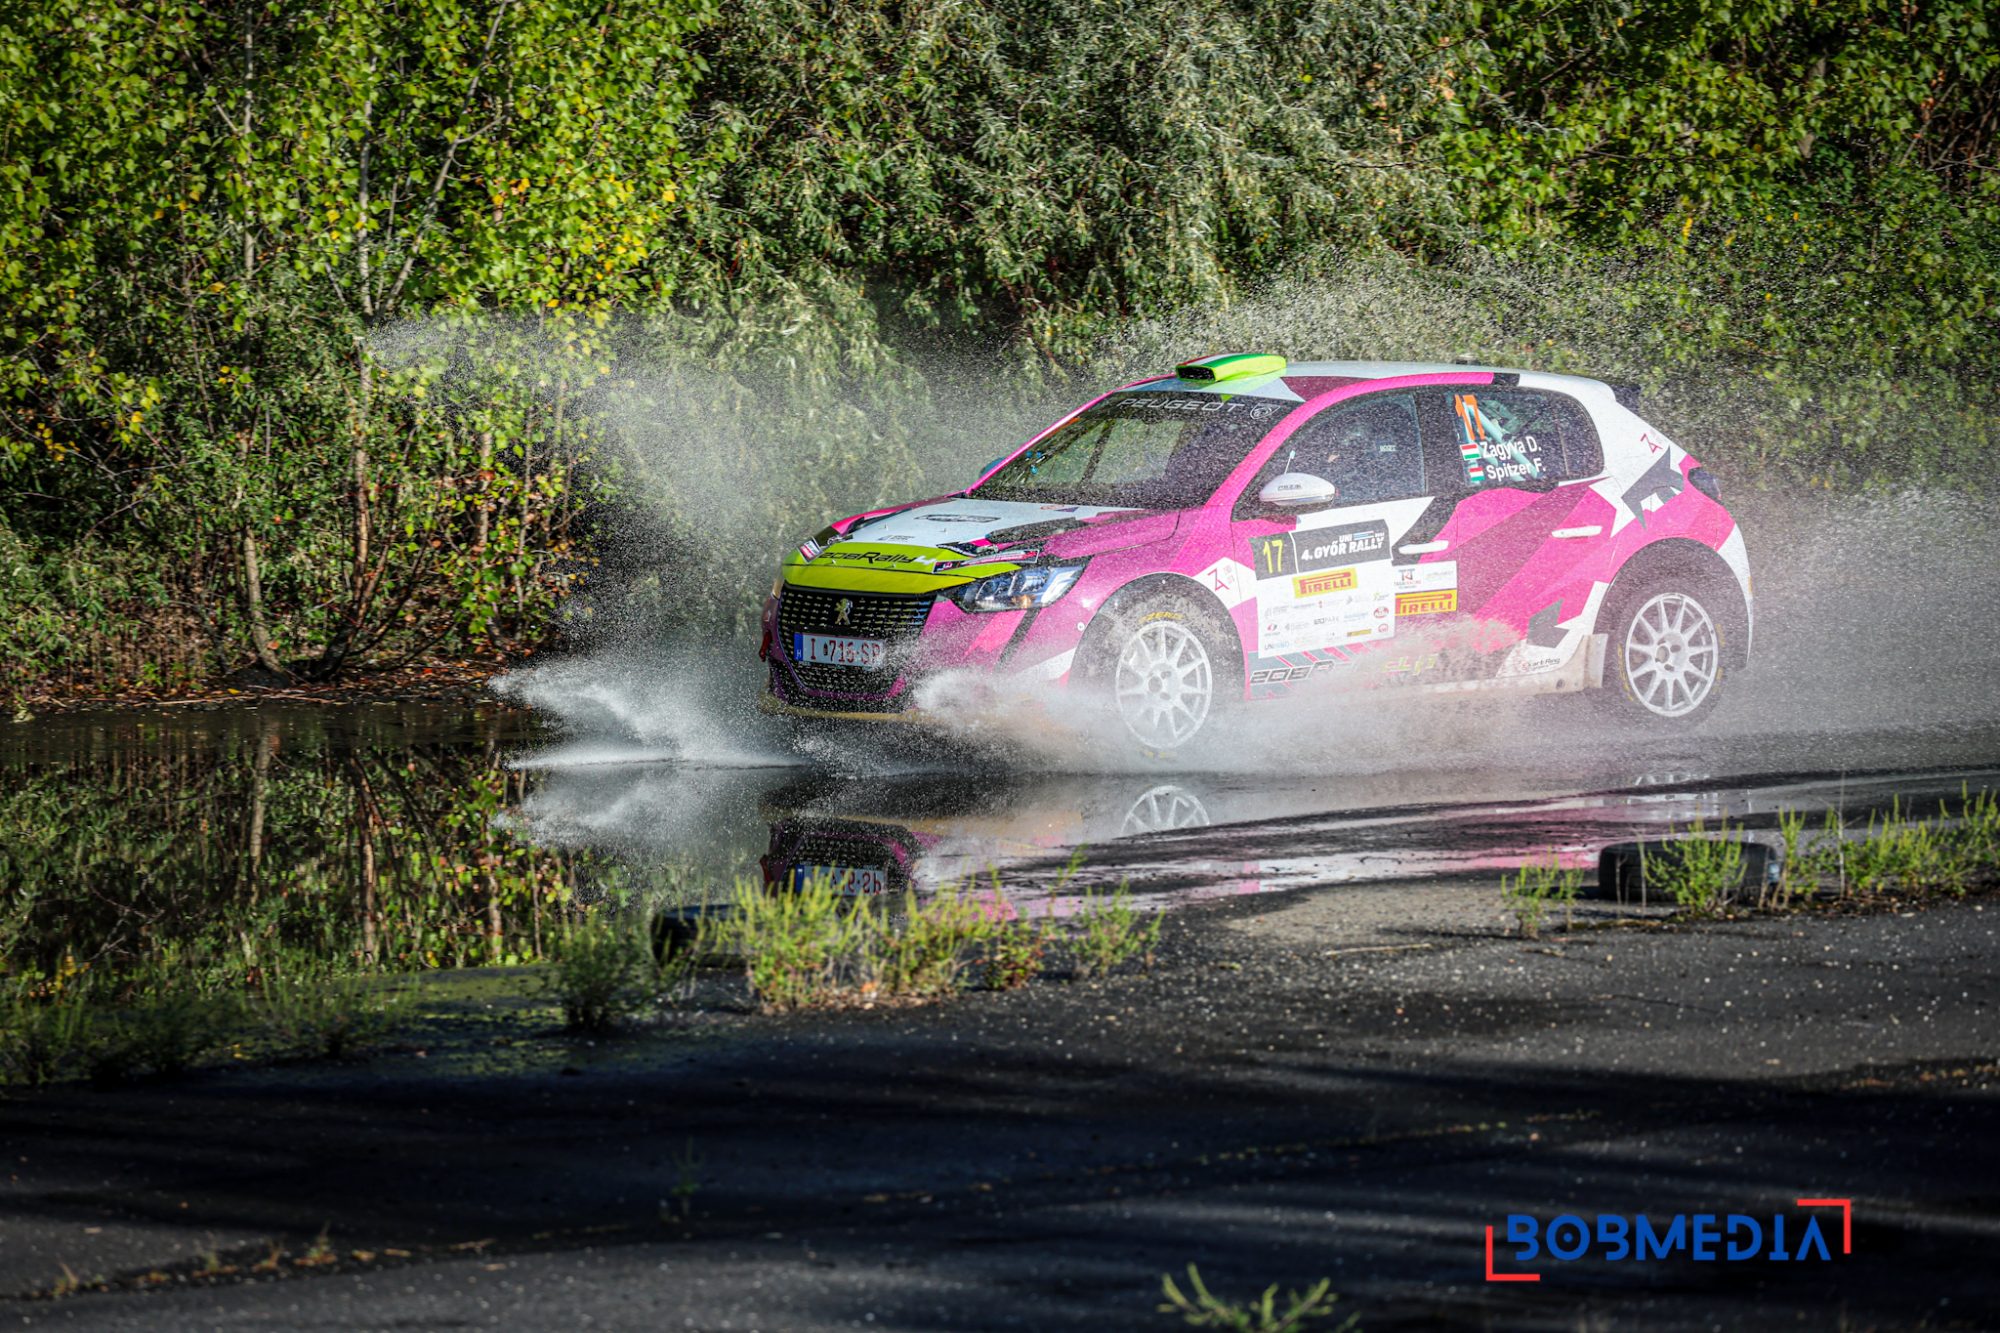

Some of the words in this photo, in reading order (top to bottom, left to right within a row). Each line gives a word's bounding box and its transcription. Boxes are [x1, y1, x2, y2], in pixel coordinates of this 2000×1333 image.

[1117, 398, 1245, 412] PEUGEOT
[1454, 394, 1486, 440] 17
[1480, 440, 1526, 460] Zagyva
[1525, 435, 1542, 452] D.
[1486, 462, 1532, 481] Spitzer
[1533, 457, 1547, 473] F.
[1263, 539, 1283, 574] 17
[1348, 536, 1385, 554] RALLY
[1299, 572, 1352, 595] PIRELLI
[1395, 593, 1453, 614] PIRELLI
